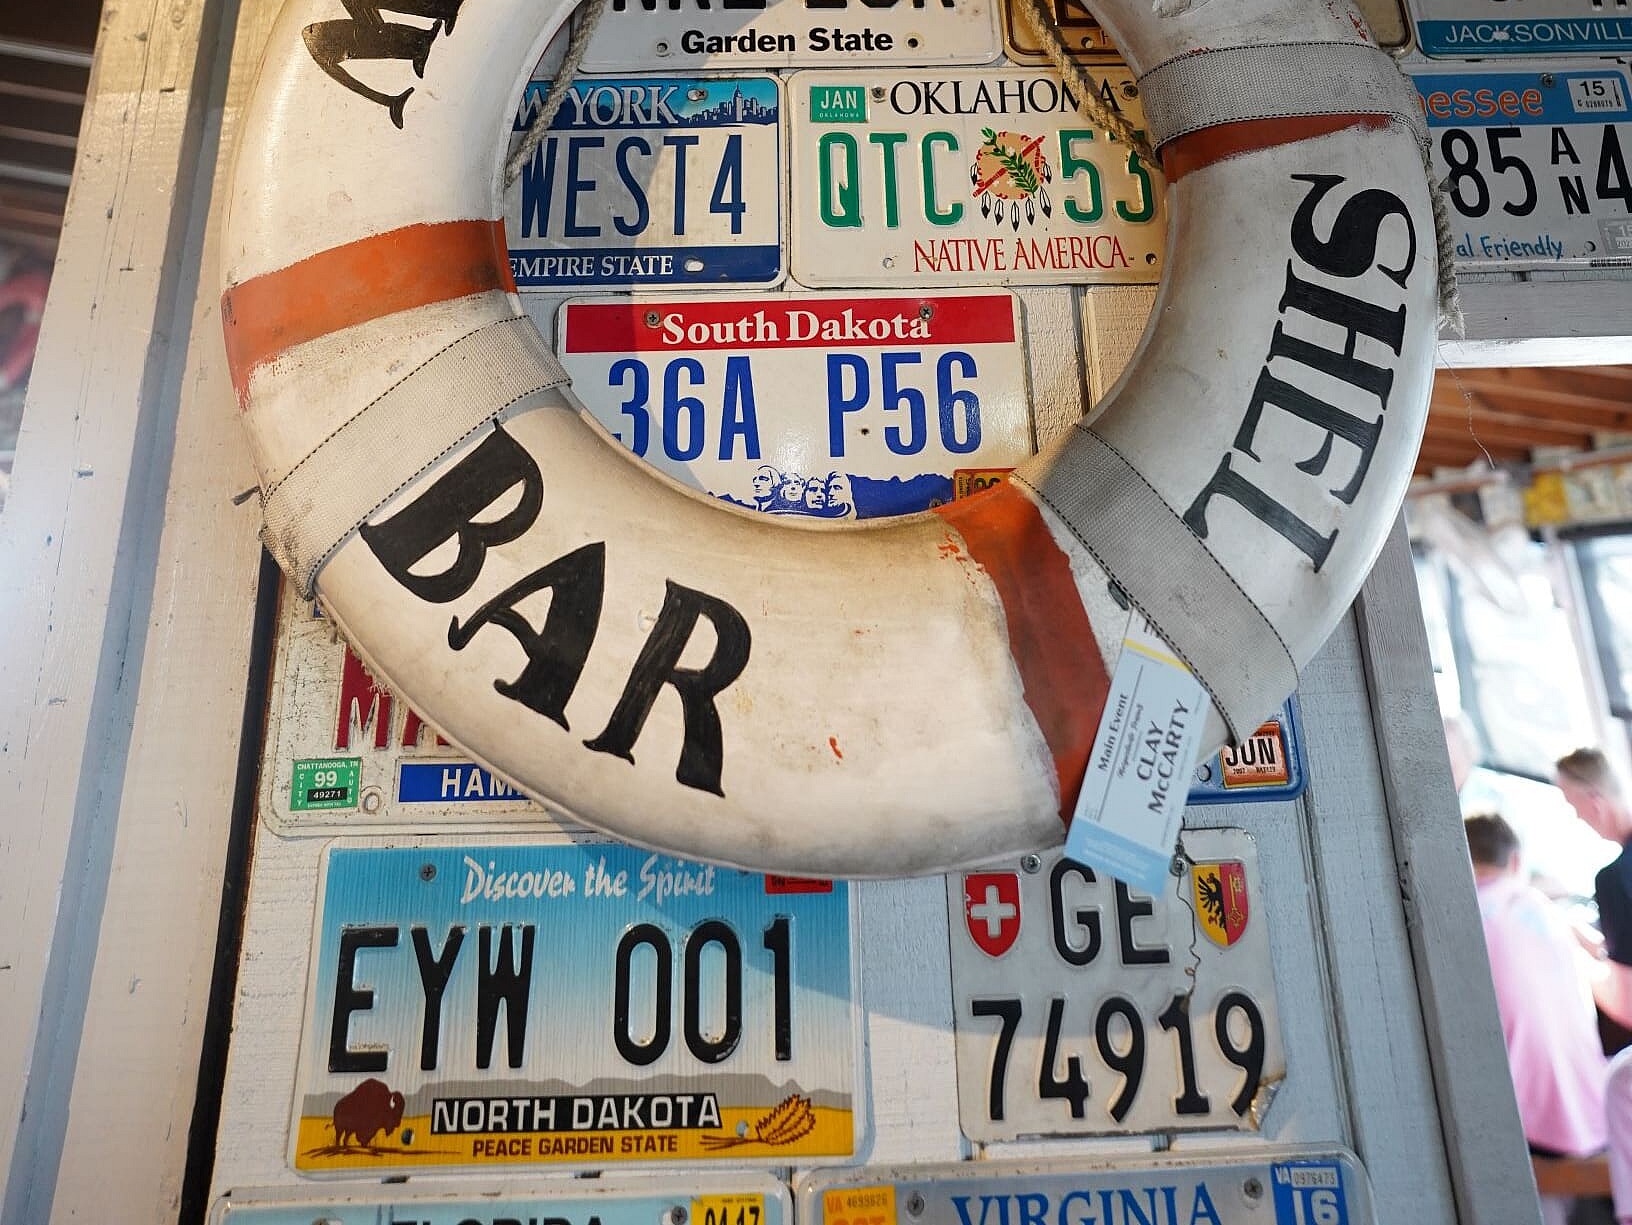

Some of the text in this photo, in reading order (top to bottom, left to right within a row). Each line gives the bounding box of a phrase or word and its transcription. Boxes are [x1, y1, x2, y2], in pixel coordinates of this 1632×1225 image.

[681, 28, 894, 55] Garden State
[566, 85, 681, 126] YORK
[820, 89, 858, 110] JAN
[1580, 80, 1606, 97] 15
[818, 130, 964, 228] QTC
[601, 255, 674, 276] STATE
[913, 235, 1130, 273] NATIVE AMERICA
[1480, 234, 1563, 261] Friendly
[662, 305, 931, 345] South Dakota
[608, 351, 982, 462] 36A P56
[358, 418, 754, 799] BAR
[1098, 694, 1129, 771] Main Event
[1136, 719, 1164, 782] CLAY
[1225, 738, 1276, 767] JUN
[1147, 698, 1190, 815] McCARTY
[314, 771, 338, 787] 99
[441, 767, 530, 798] HAM
[460, 854, 715, 907] Discover the Spirit
[1050, 857, 1170, 967] GE
[328, 918, 793, 1073] EYW 001
[971, 993, 1266, 1124] 74919
[433, 1094, 720, 1133] NORTH DAKOTA
[473, 1134, 678, 1157] PEACE GARDEN STATE
